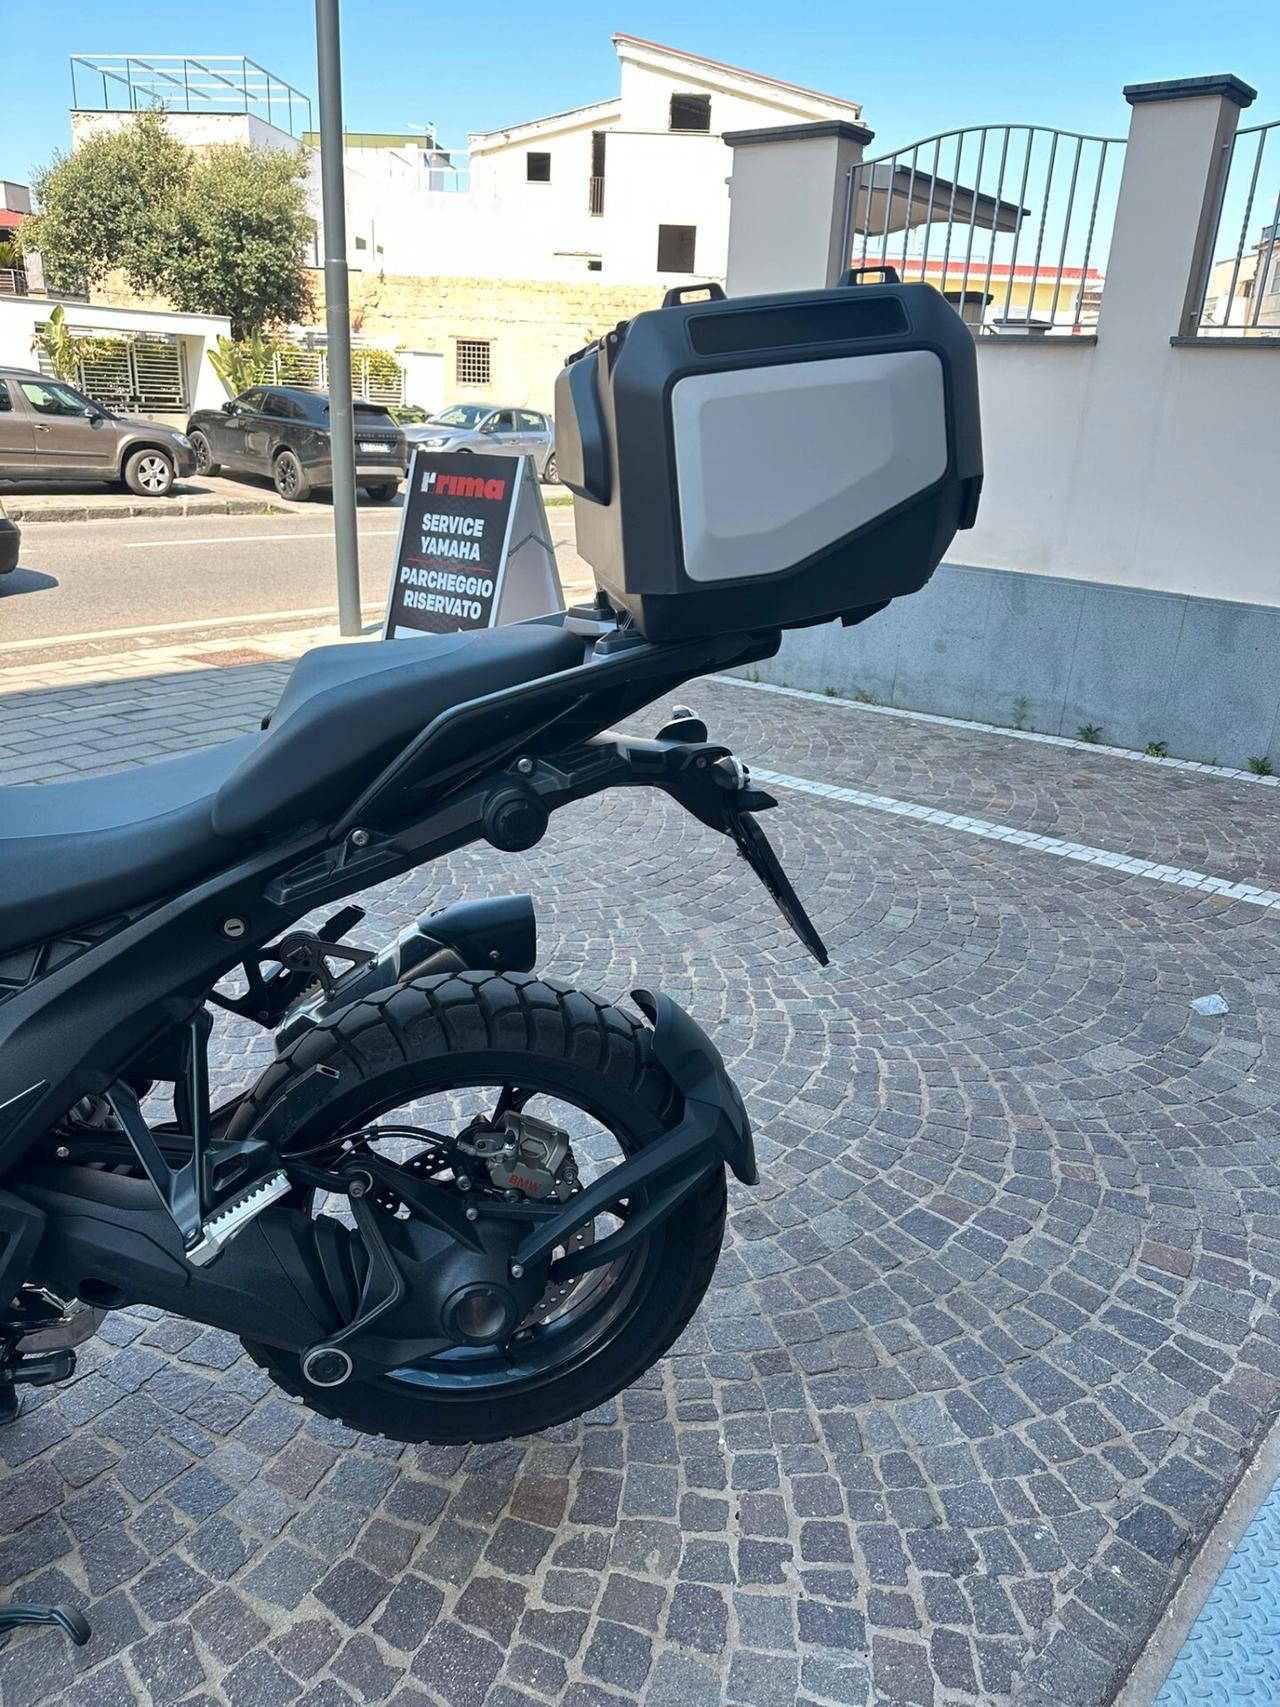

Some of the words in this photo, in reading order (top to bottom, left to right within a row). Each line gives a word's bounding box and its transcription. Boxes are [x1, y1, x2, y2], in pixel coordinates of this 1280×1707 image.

[422, 513, 484, 537] SERVICE
[421, 536, 480, 561] YAMAHA
[400, 566, 493, 597] PARCHEGGIO
[403, 590, 482, 620] RISERVATO
[508, 1174, 542, 1192] BMW
